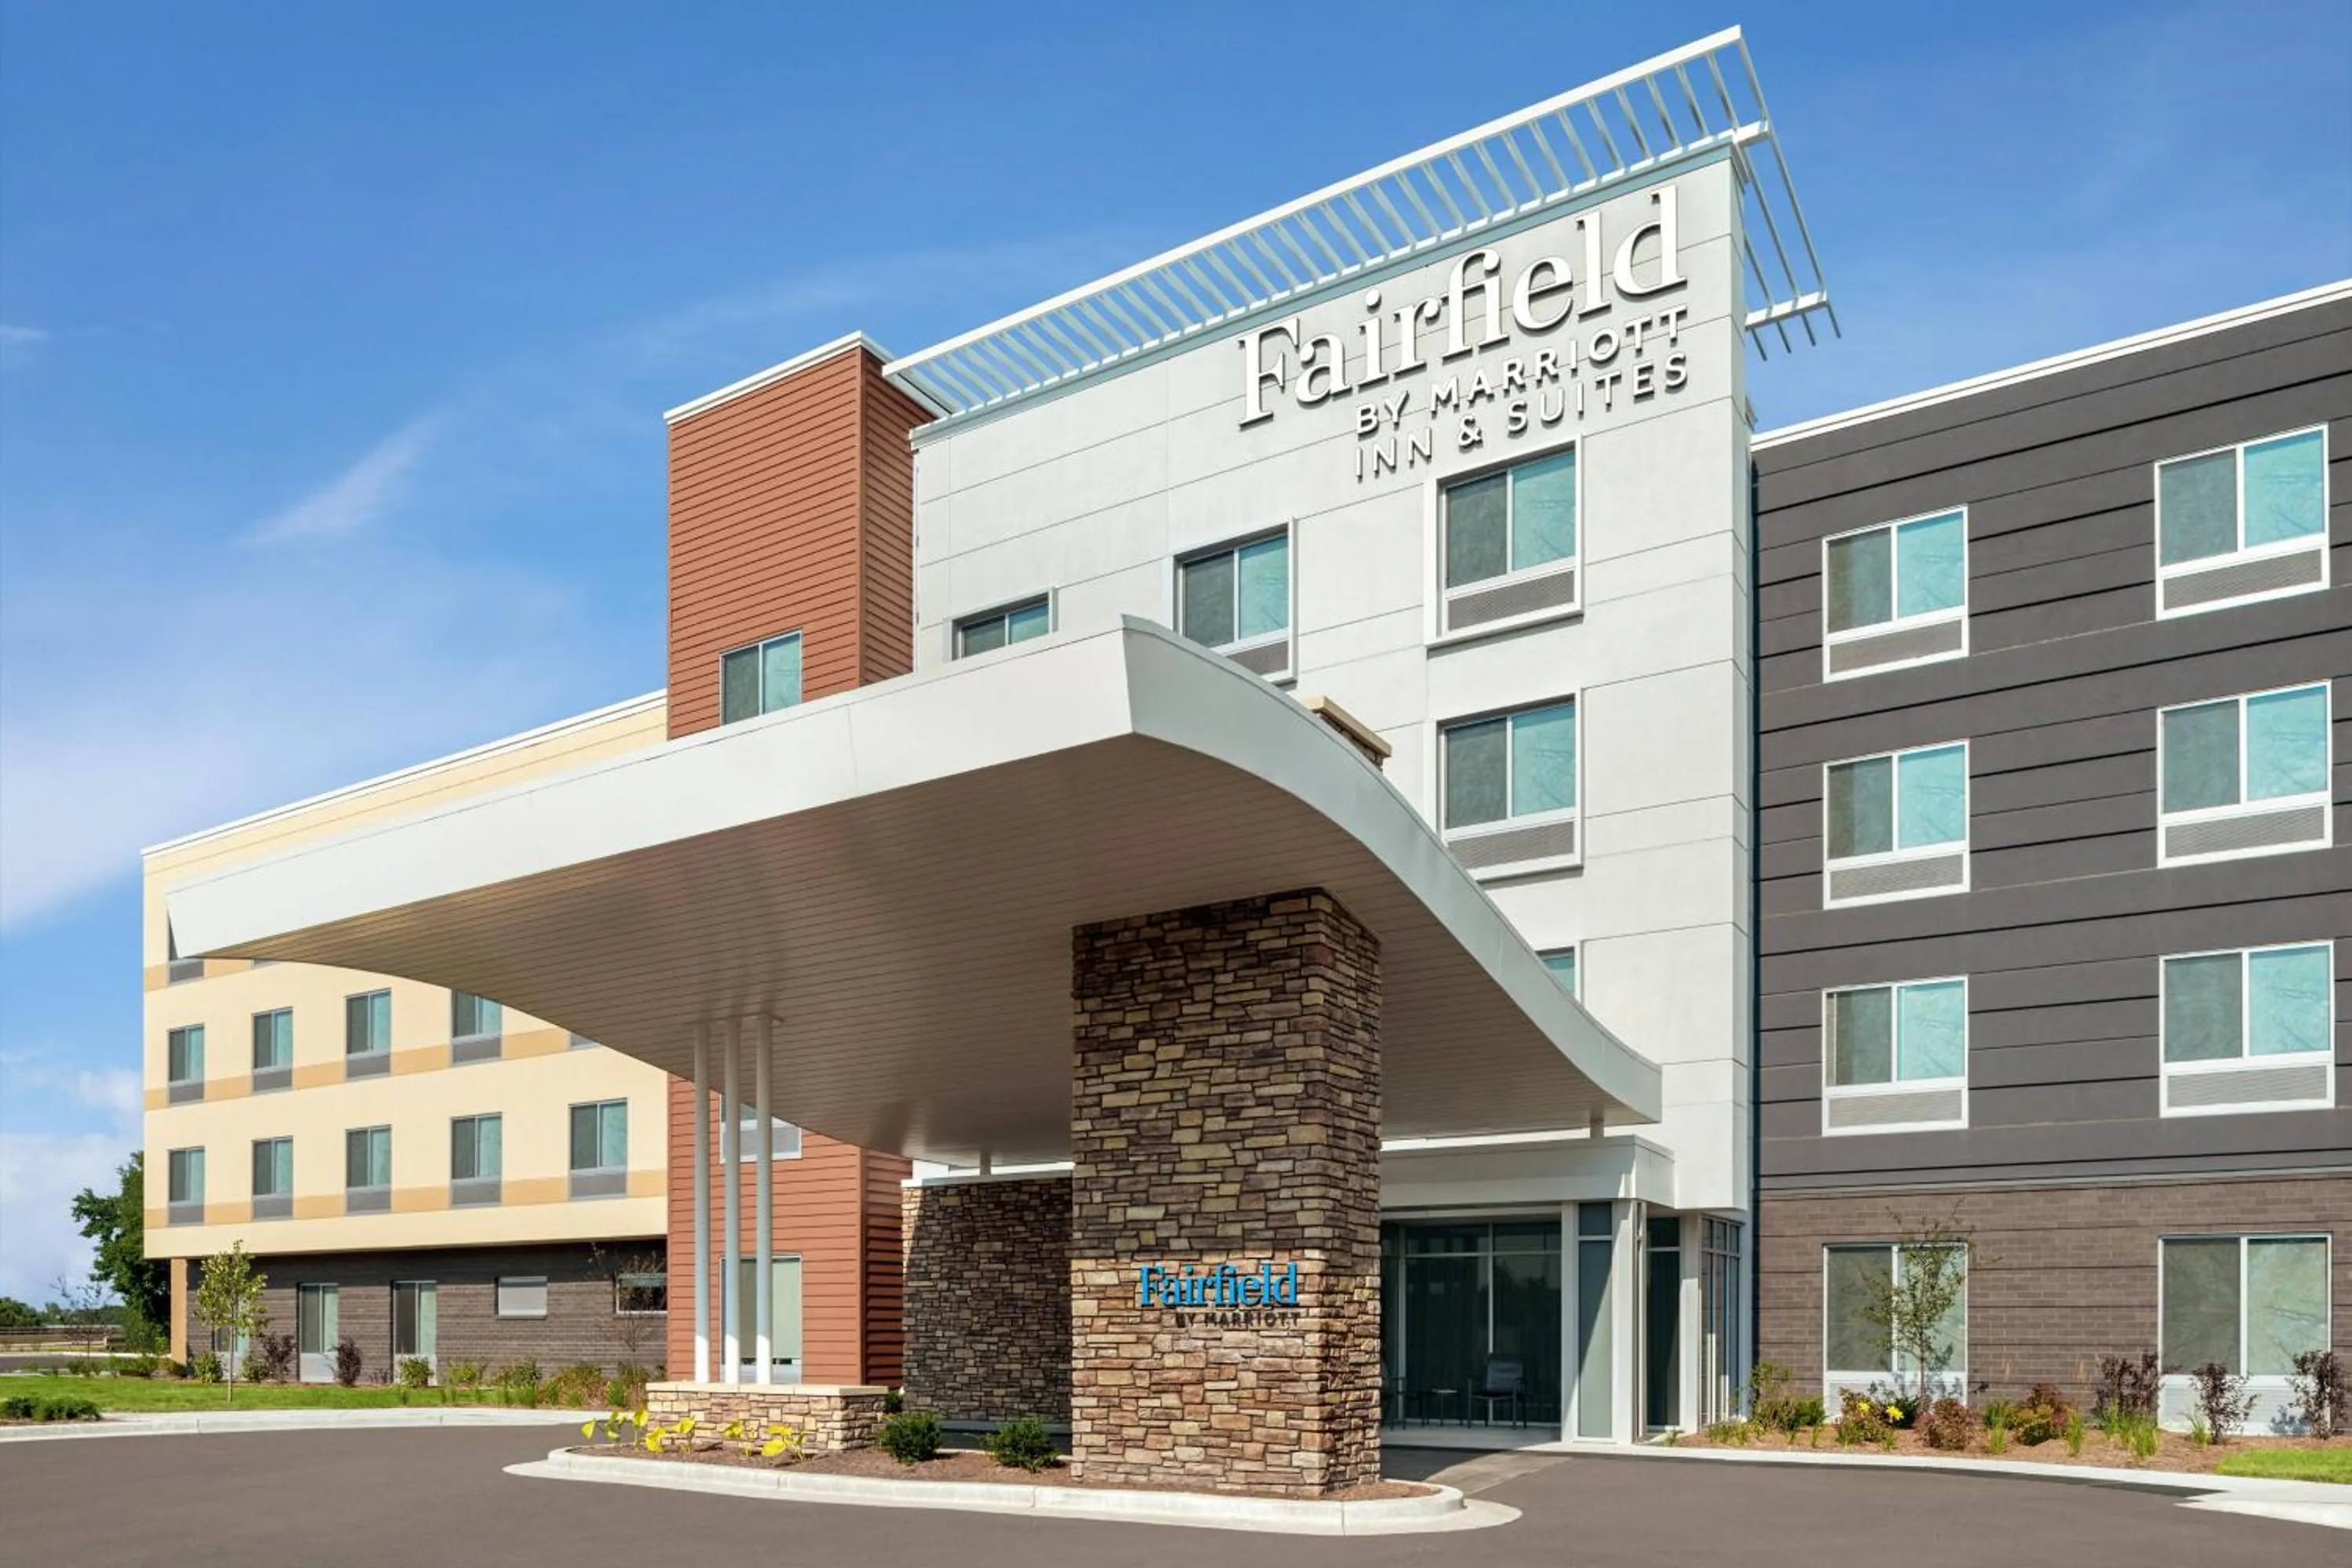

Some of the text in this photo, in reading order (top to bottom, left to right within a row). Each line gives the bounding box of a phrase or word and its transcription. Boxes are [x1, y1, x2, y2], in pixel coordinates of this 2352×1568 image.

[1239, 185, 1688, 429] Fairfield
[1356, 305, 1688, 436] BY MARRIOTT
[1356, 352, 1688, 481] INN & SUITES
[1140, 1261, 1299, 1308] Fairfield
[1176, 1312, 1300, 1327] BY MARRIOTT
